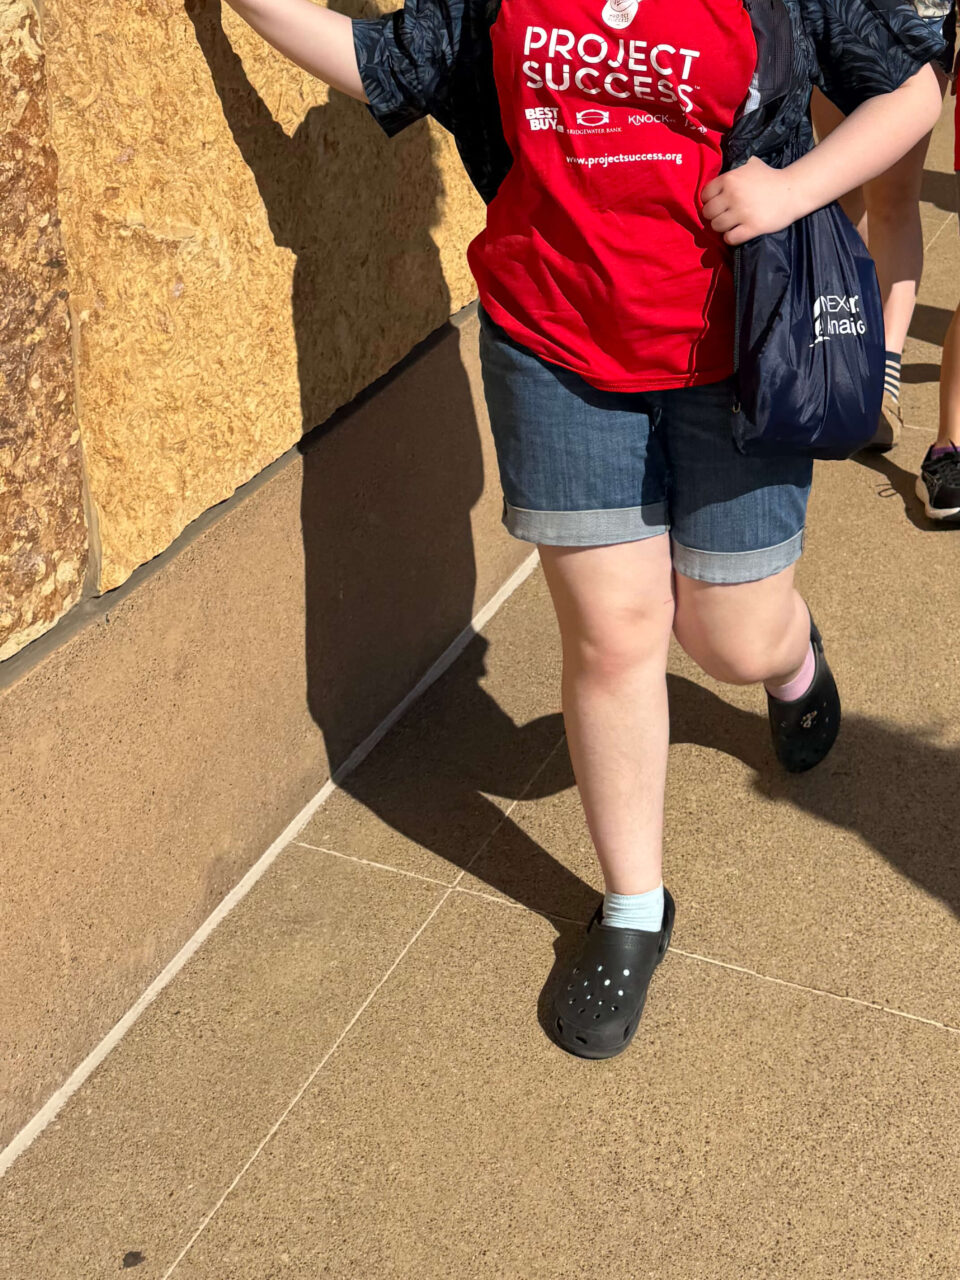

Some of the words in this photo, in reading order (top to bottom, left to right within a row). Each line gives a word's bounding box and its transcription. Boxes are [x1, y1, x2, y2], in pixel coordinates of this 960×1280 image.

[523, 26, 701, 80] PROJECT
[522, 60, 694, 113] SUCCESS
[525, 107, 559, 120] BEST
[628, 114, 669, 126] KNOCK
[529, 119, 558, 131] BUY
